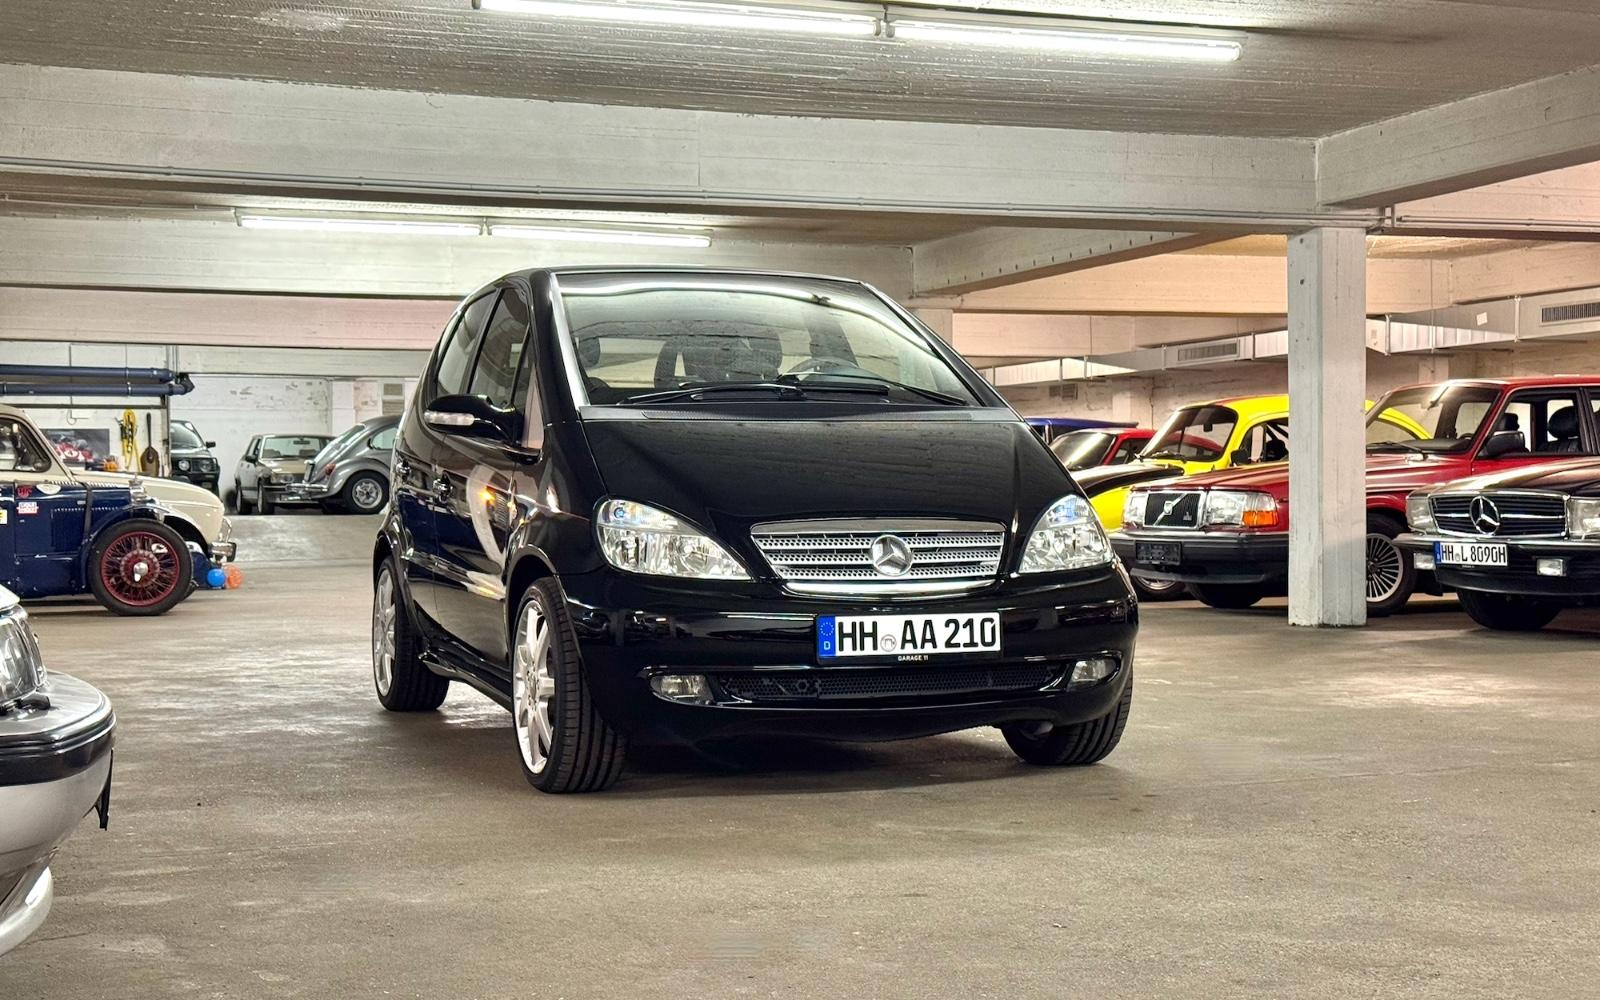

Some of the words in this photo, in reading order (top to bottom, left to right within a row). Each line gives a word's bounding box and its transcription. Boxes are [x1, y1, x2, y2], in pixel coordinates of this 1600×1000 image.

[1441, 545, 1454, 561] HH
[1461, 545, 1468, 562] L
[1470, 545, 1506, 564] 8090H
[838, 621, 878, 651] HH
[900, 619, 938, 650] AA
[944, 617, 996, 648] 210
[823, 641, 831, 650] D
